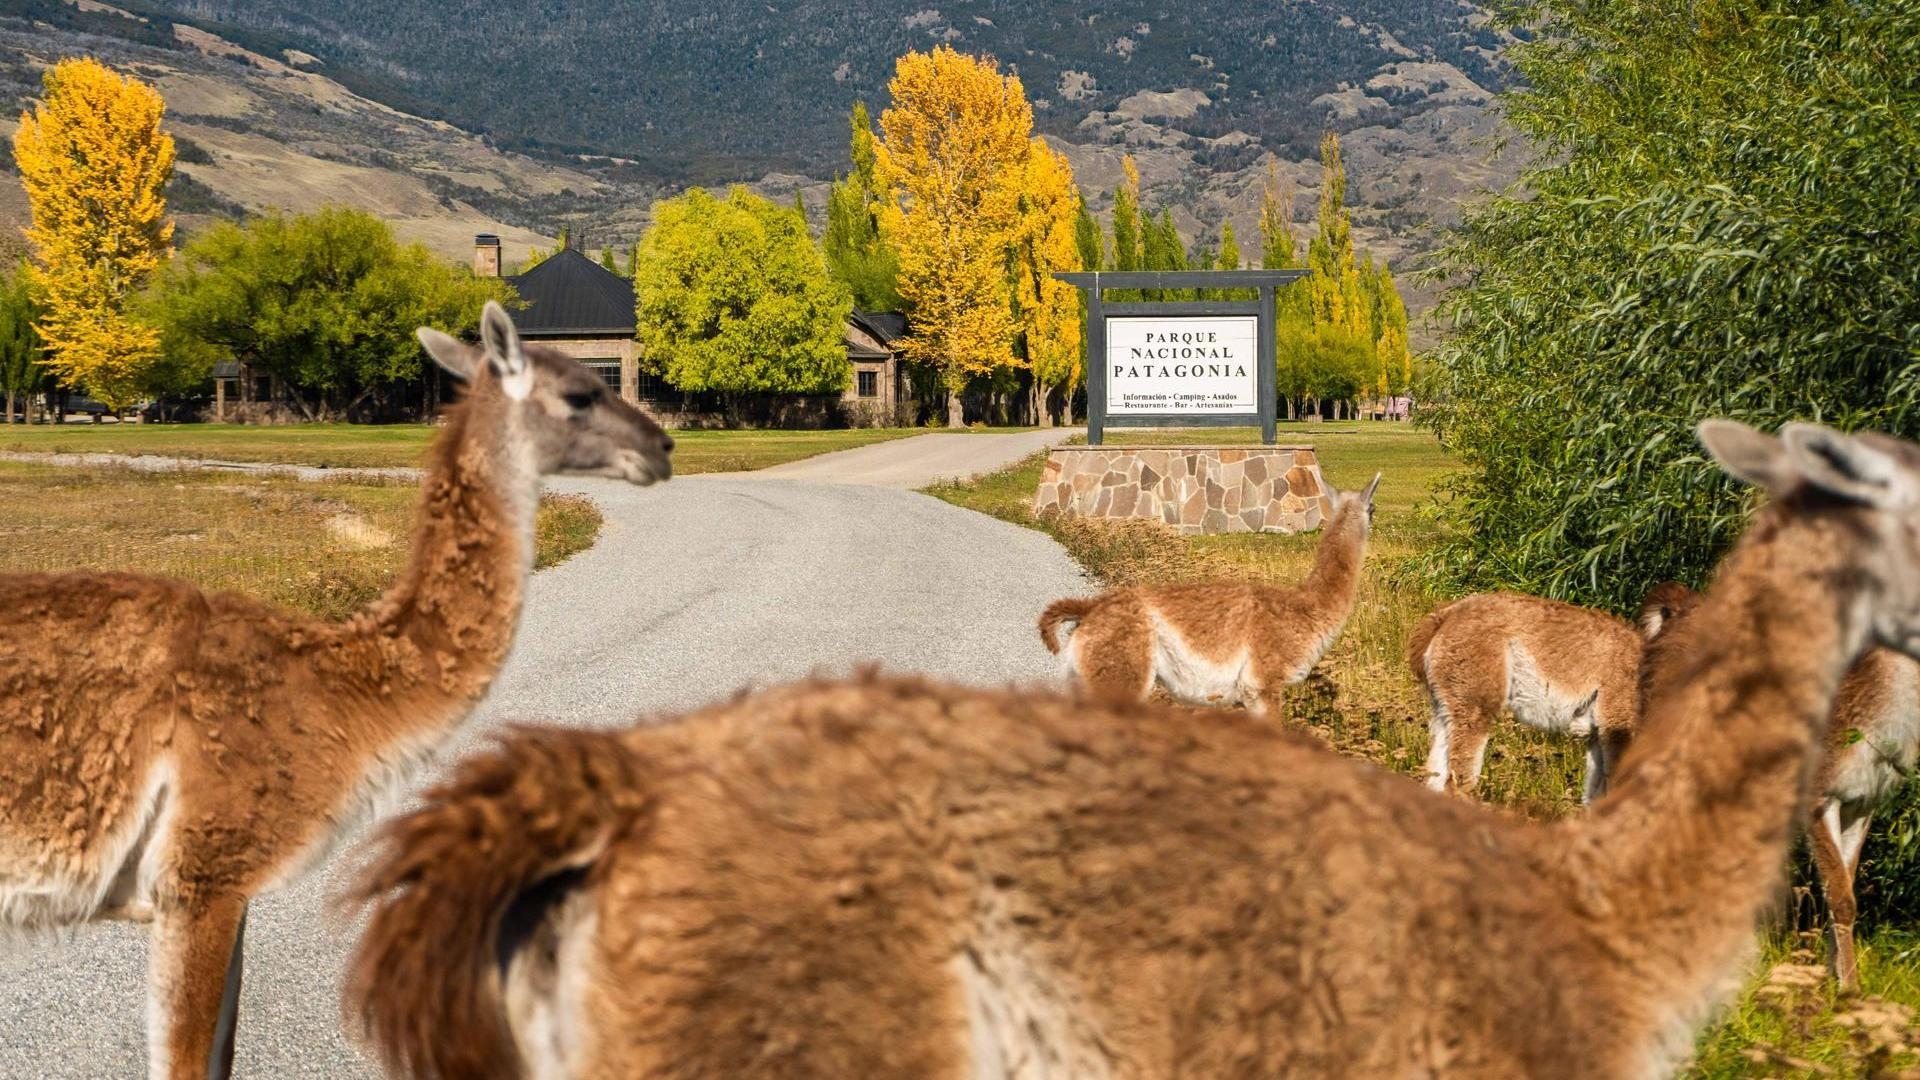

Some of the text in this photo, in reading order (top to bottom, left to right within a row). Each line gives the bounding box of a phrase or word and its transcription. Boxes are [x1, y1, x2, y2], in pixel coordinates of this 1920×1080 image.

[1147, 332, 1217, 344] PARQUE
[1131, 347, 1233, 359] NACIONAL
[1114, 365, 1246, 377] PATAGONIA
[1173, 393, 1206, 402] Camping
